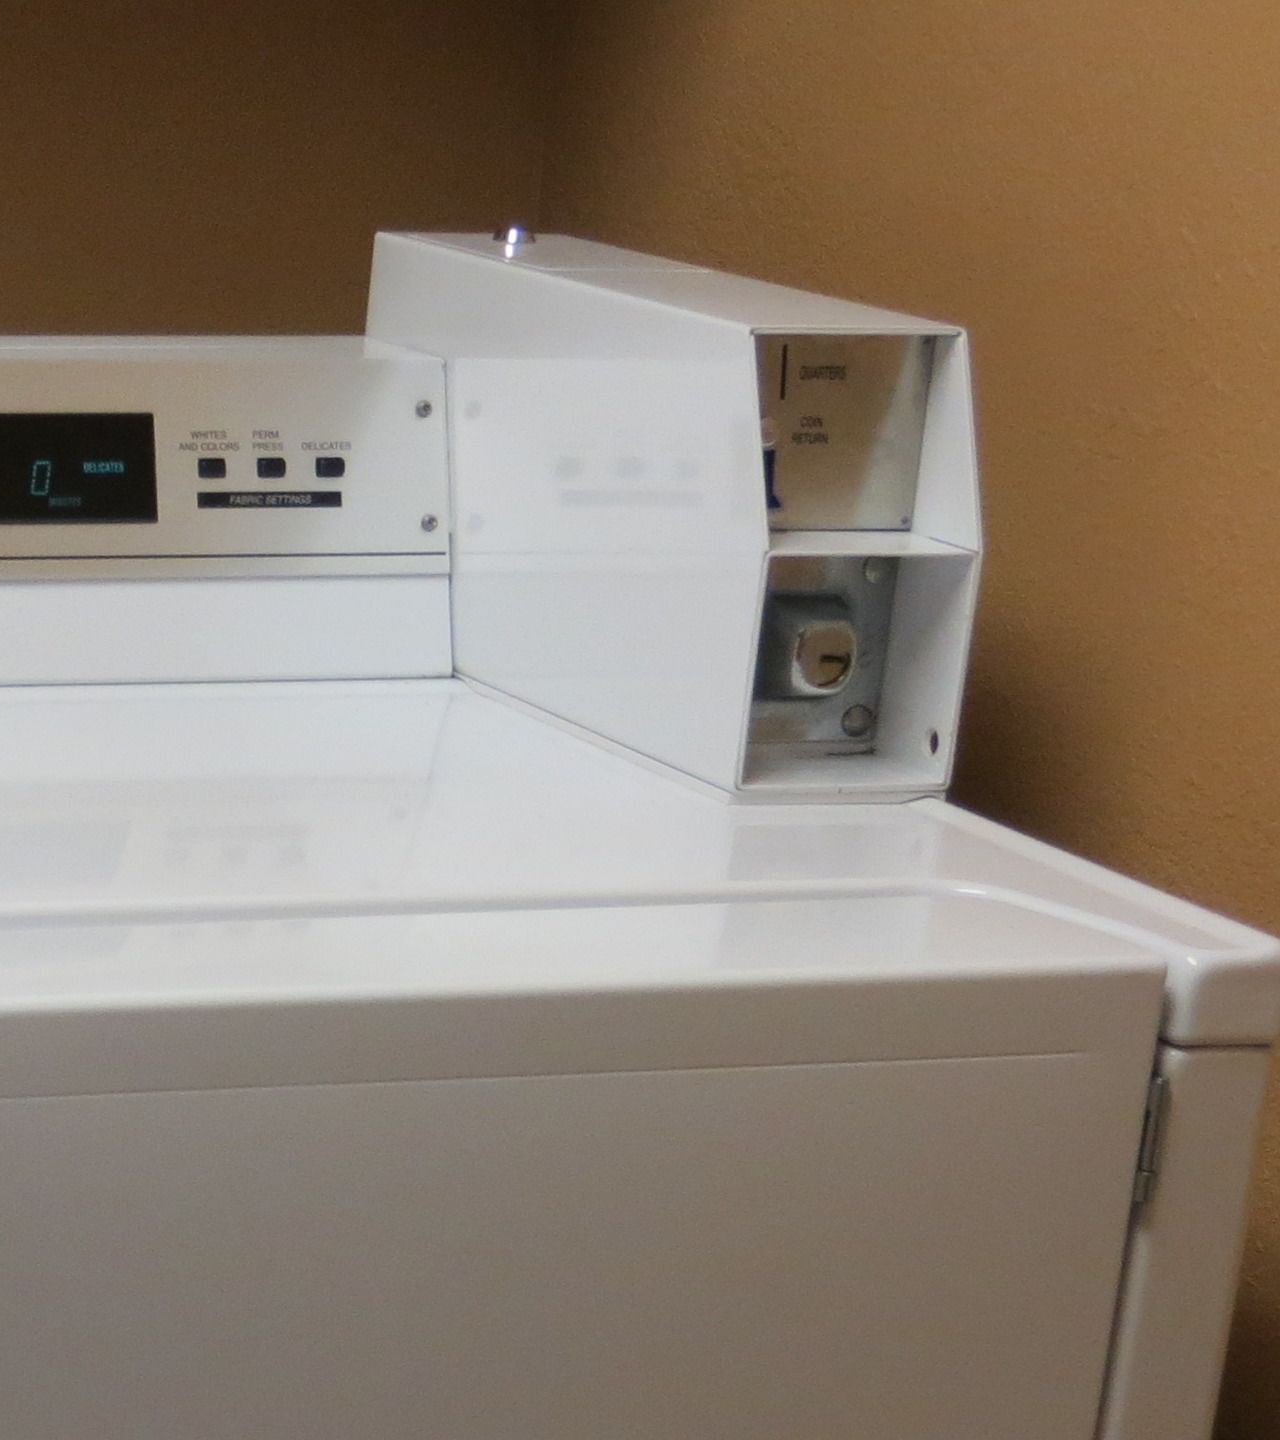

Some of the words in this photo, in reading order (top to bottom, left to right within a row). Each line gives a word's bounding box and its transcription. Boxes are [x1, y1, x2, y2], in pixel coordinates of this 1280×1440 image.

[799, 365, 847, 380] QUARTERS
[800, 415, 823, 428] COIN
[190, 430, 227, 440] WHITES
[252, 430, 279, 439] PERM
[792, 432, 828, 444] RETURN
[179, 443, 198, 451] AND
[200, 442, 239, 451] COLORS
[252, 442, 283, 450] PRESS
[301, 442, 352, 450] DELICATES
[83, 462, 124, 473] DELICATES
[229, 495, 264, 505] FABRIC
[266, 494, 312, 504] SETTINGS
